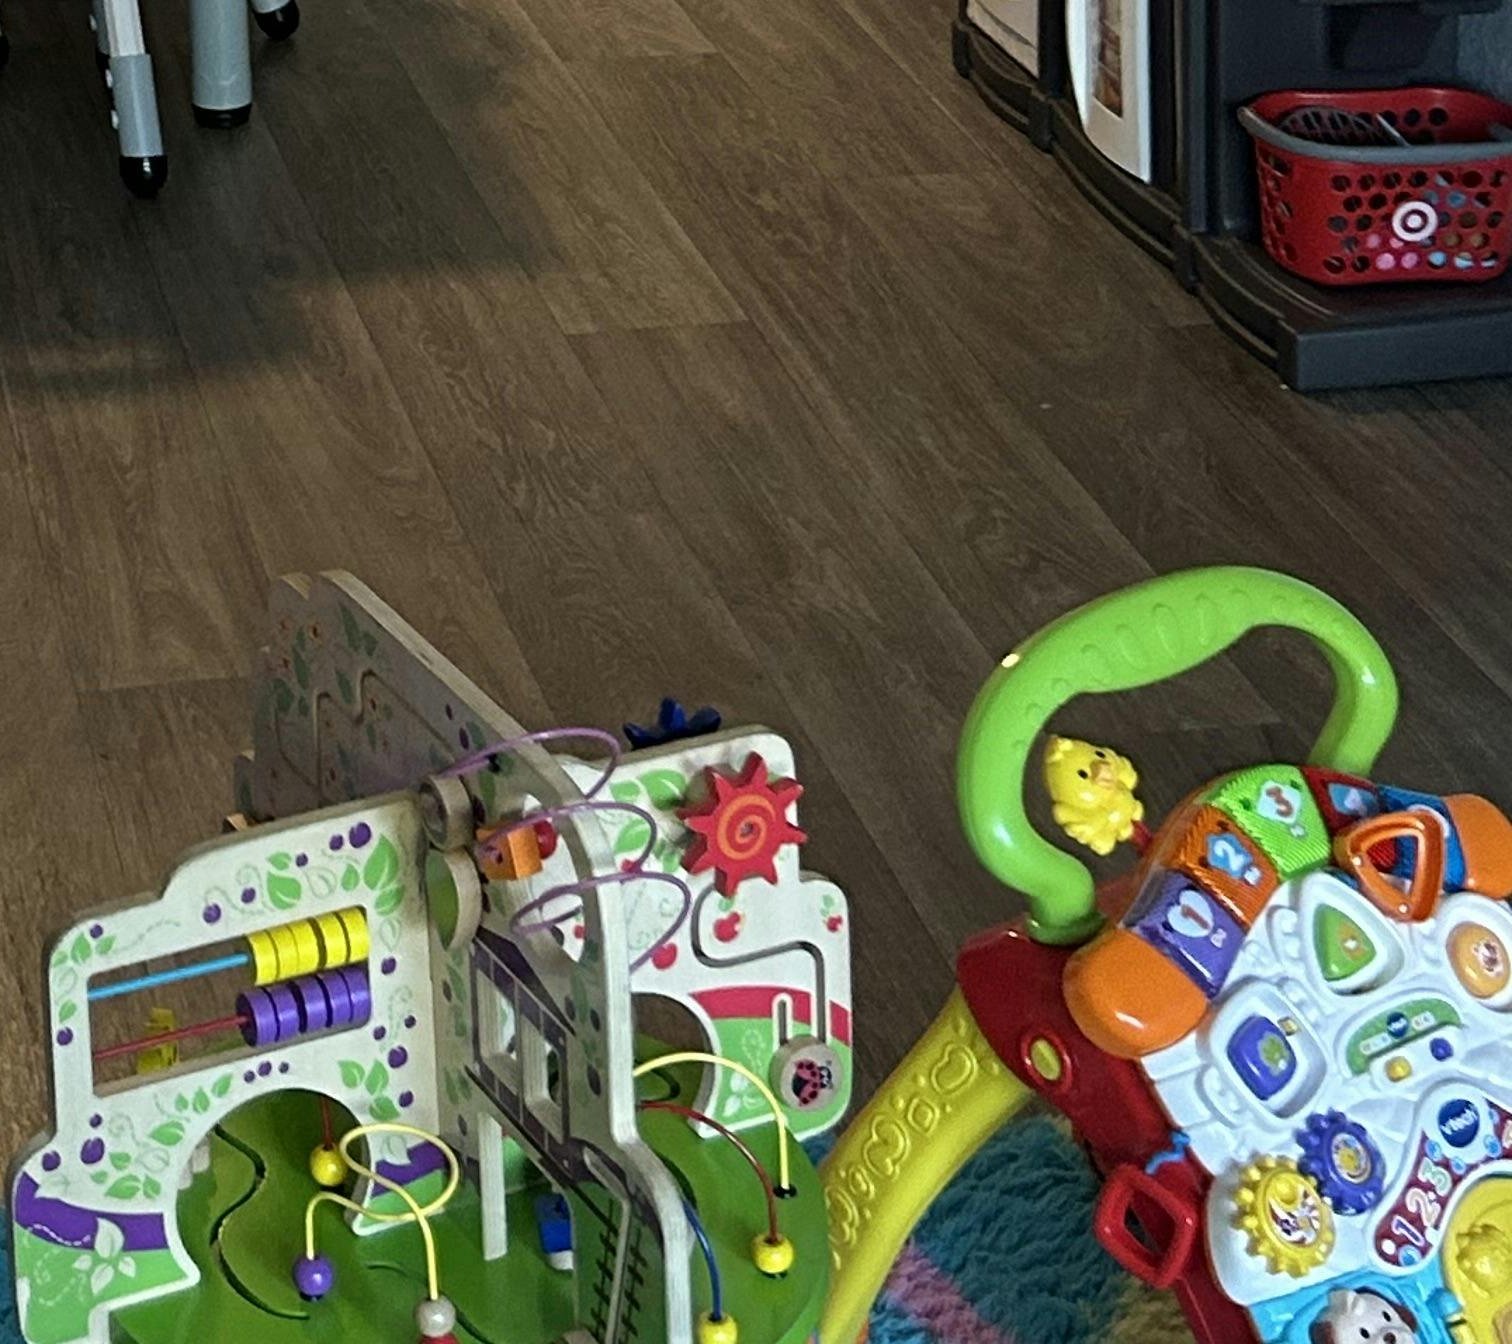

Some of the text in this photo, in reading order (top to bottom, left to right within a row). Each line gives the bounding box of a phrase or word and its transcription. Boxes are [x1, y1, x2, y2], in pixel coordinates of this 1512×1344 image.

[1213, 839, 1245, 878] 2
[1392, 1157, 1452, 1248] 1 2 3
